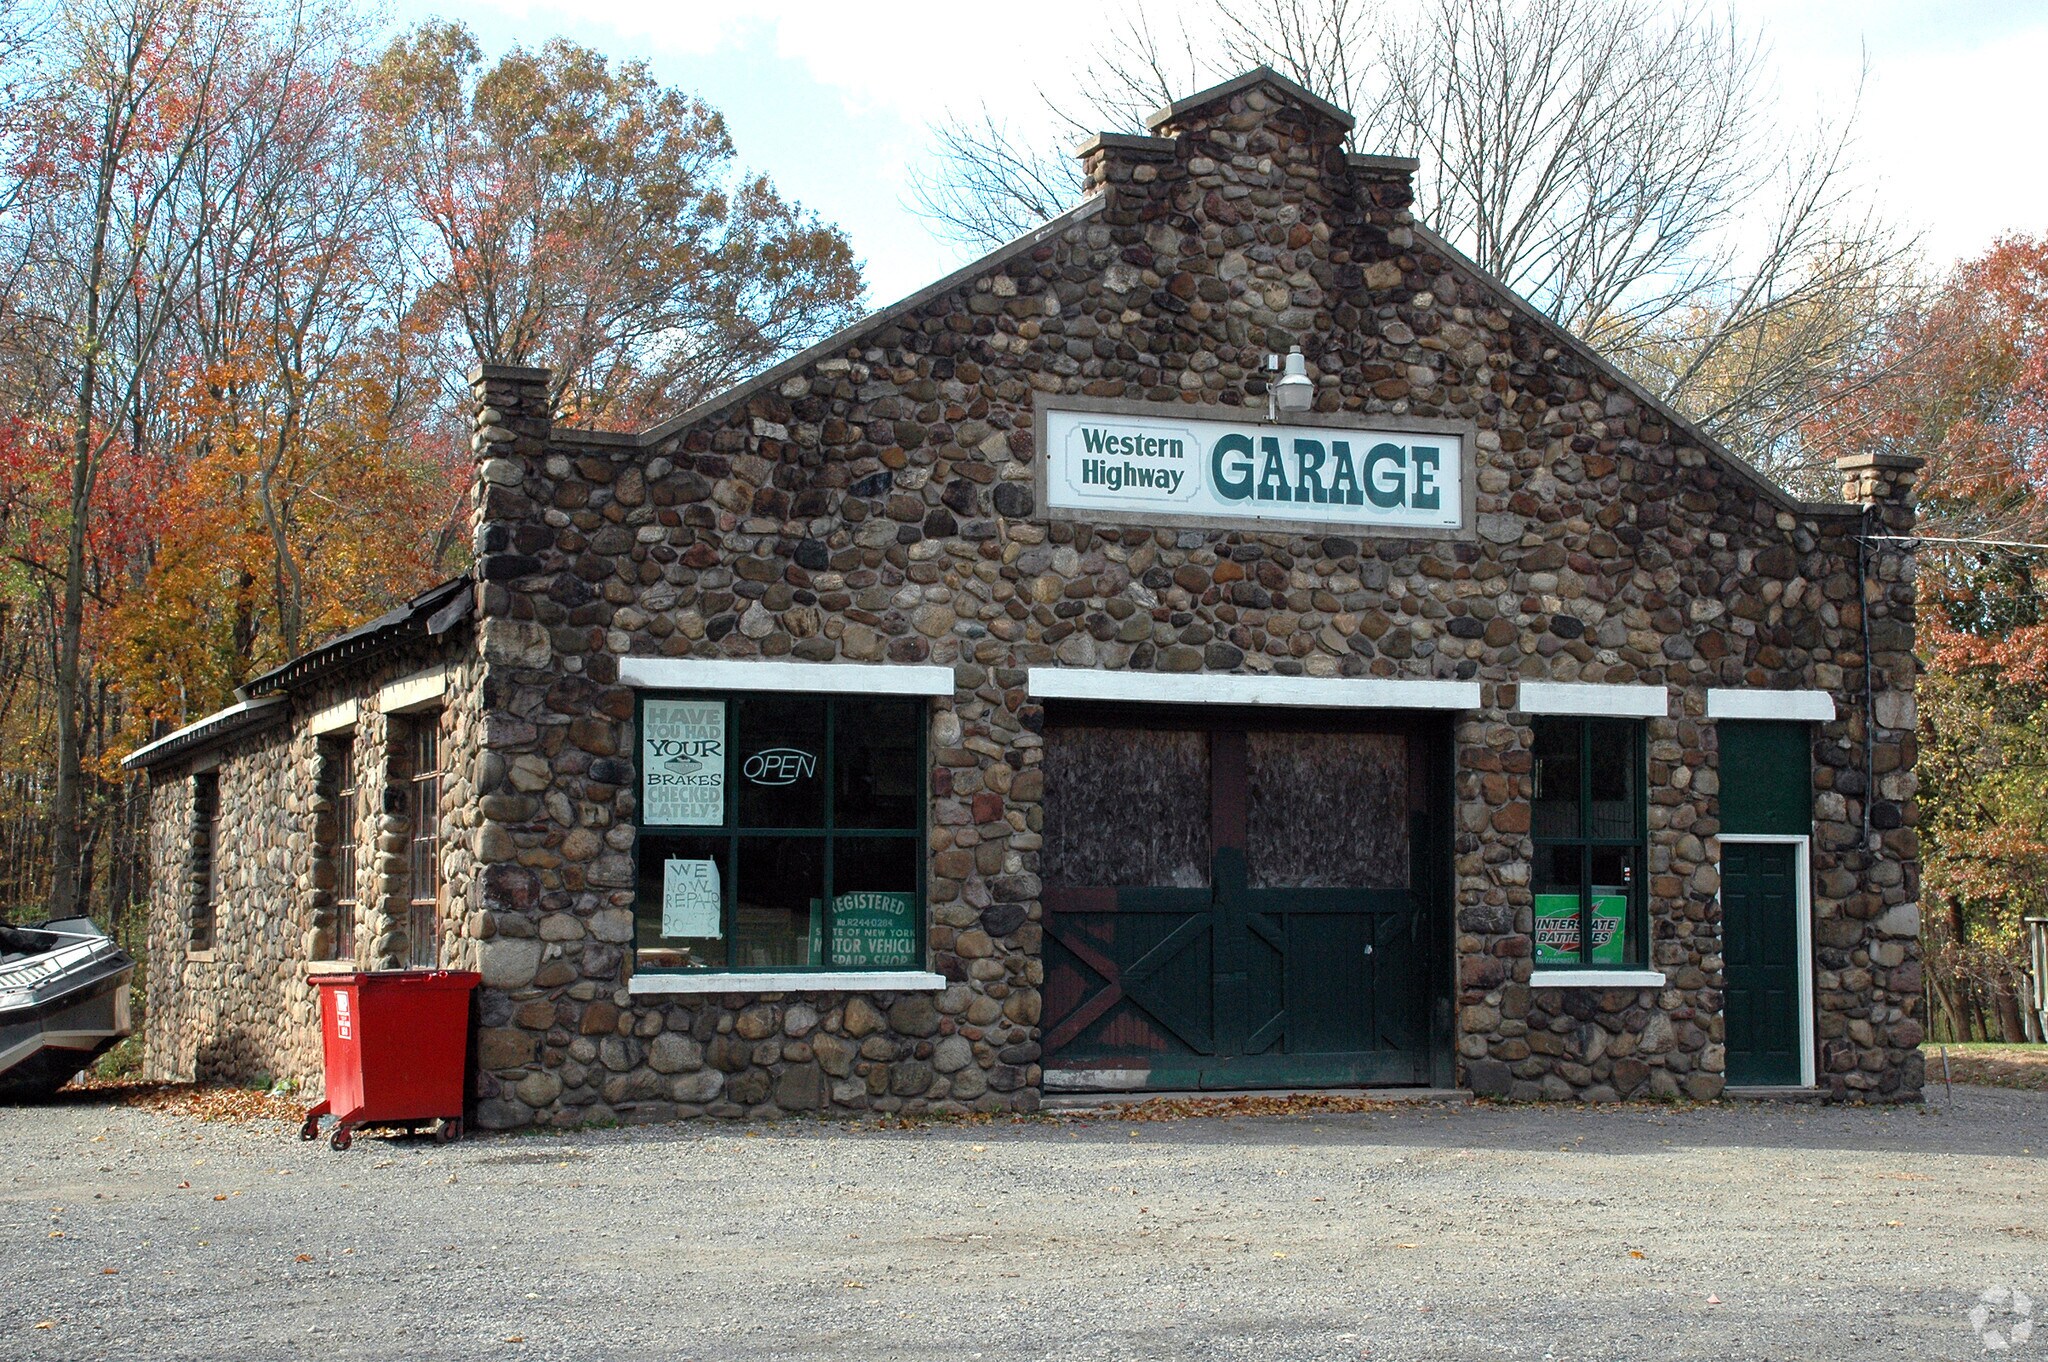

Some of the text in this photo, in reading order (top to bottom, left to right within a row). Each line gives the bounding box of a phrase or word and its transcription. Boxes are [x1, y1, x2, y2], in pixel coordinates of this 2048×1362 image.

[1081, 427, 1184, 459] Western
[1081, 458, 1185, 495] Highway
[1211, 433, 1440, 511] GARAGE
[648, 707, 720, 725] HAVE
[647, 724, 721, 740] YOU HAD
[647, 739, 722, 757] YOUR
[743, 755, 817, 778] OPEN
[647, 773, 722, 786] BRAKES
[647, 786, 720, 803] CHECKED
[647, 803, 720, 818] LATELY?
[670, 864, 707, 878] WE
[666, 892, 720, 911] REPAIR
[815, 927, 844, 937] STE
[847, 928, 860, 937] OF
[864, 928, 885, 937] NEW
[1536, 919, 1616, 930] INTERATE
[1538, 932, 1609, 942] BATTEES
[813, 938, 861, 953] MTOR
[832, 954, 867, 965] EPAIR
